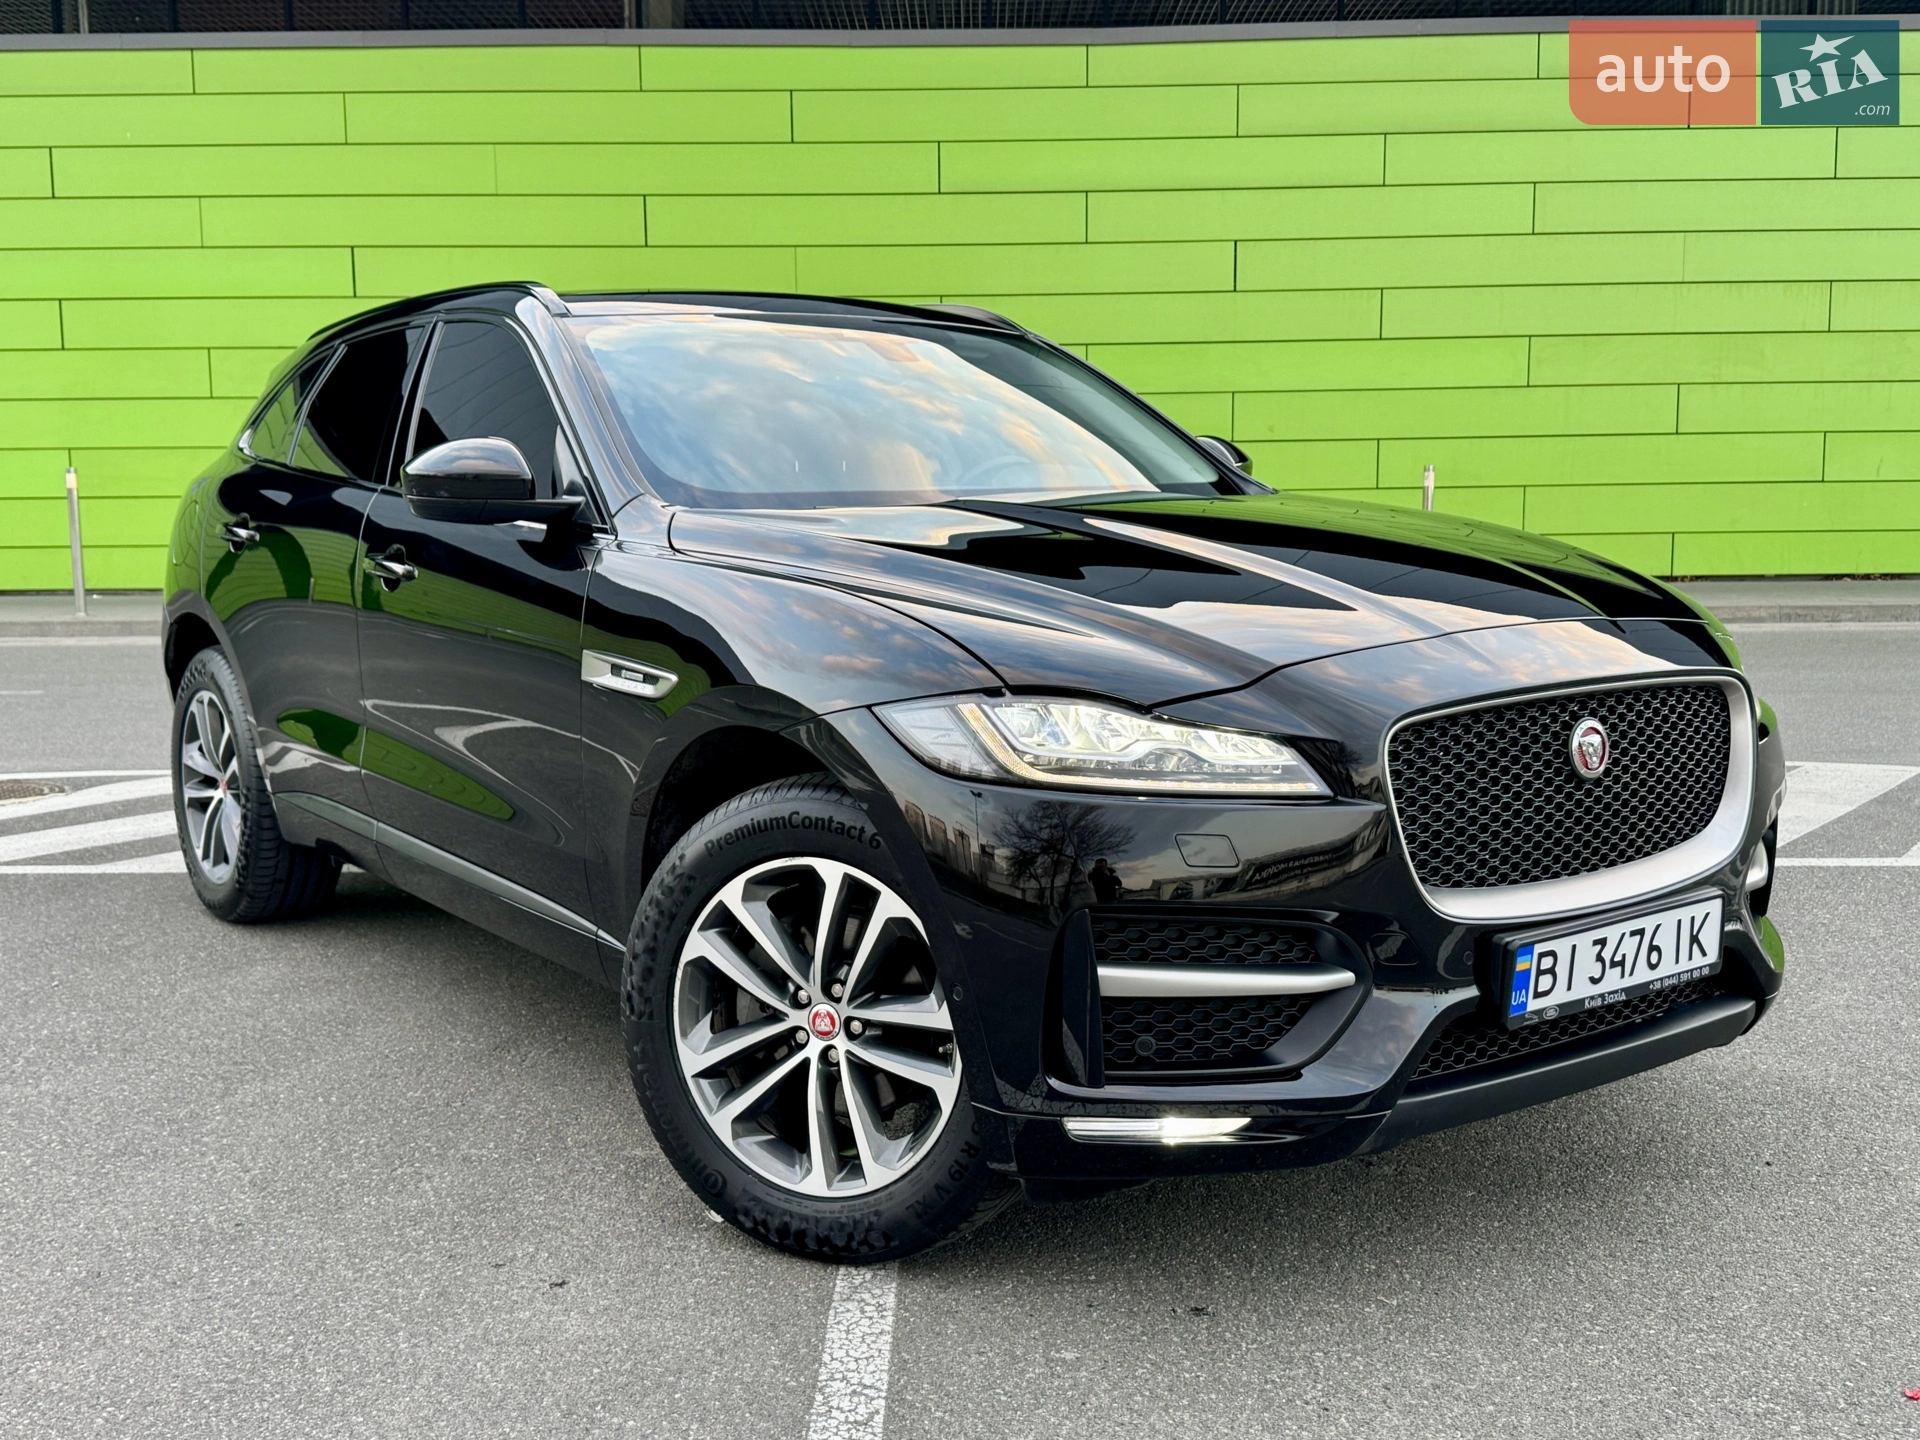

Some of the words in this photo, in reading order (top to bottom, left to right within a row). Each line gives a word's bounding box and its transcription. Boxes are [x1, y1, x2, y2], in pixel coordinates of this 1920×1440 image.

[703, 810, 866, 858] PremiumContact
[868, 831, 882, 850] 6
[1533, 944, 1576, 1000] BI
[1588, 923, 1662, 985] 3476
[1675, 911, 1711, 965] IK
[1649, 980, 1661, 990] +38
[1663, 974, 1679, 988] (044)
[1680, 971, 1691, 982] 591
[1692, 969, 1700, 978] 00
[1701, 966, 1710, 976] 00
[1511, 989, 1527, 1006] UA
